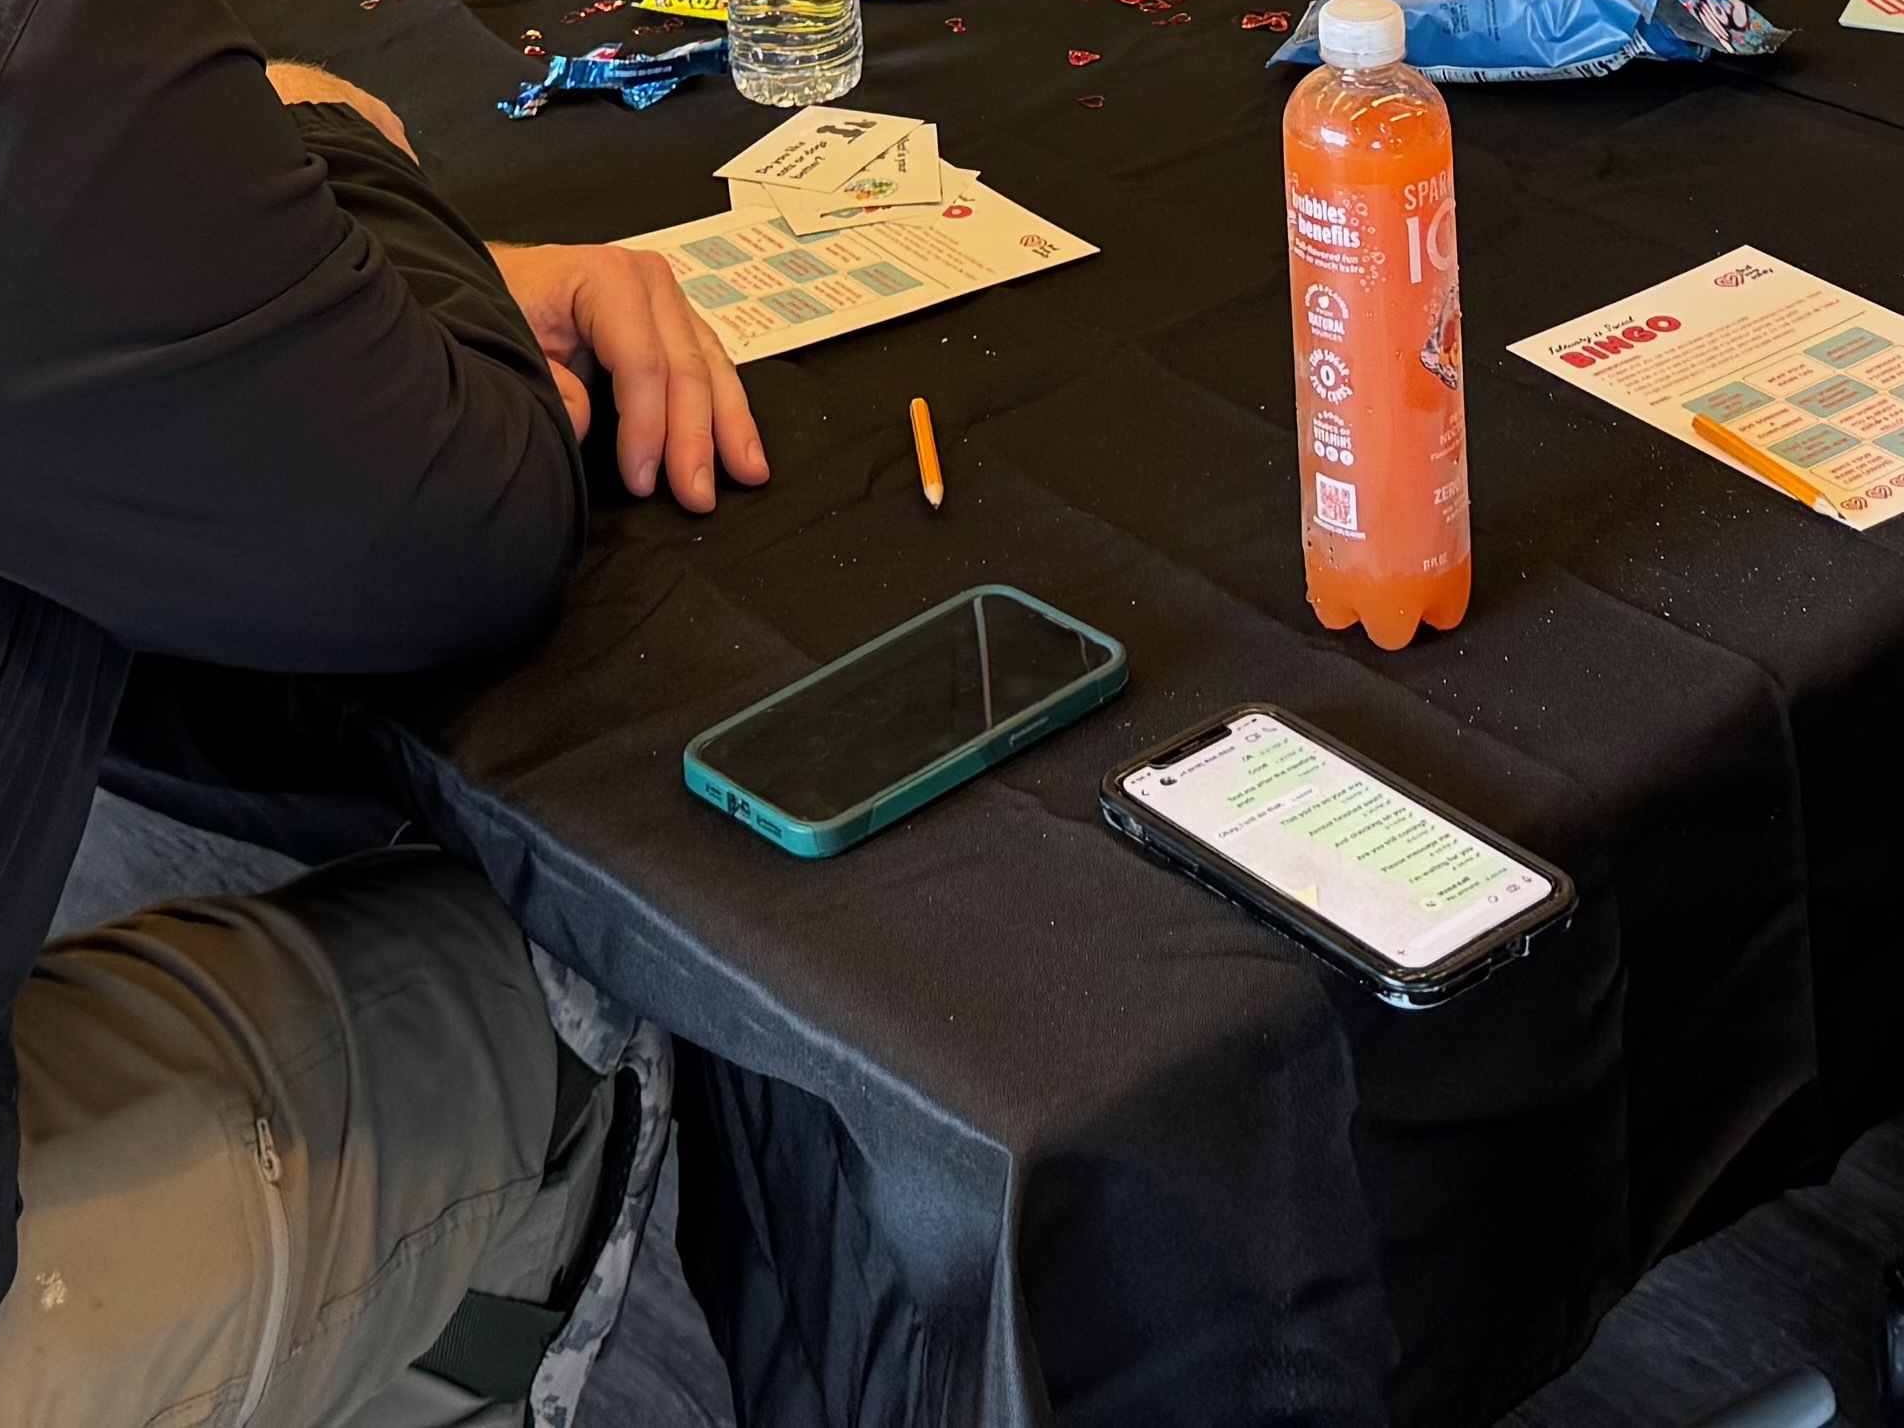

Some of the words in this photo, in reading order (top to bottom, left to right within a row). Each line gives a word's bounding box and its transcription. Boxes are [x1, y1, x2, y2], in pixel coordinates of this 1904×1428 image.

[1291, 186, 1347, 225] bubbles
[1298, 213, 1361, 249] benefits
[1405, 196, 1457, 284] IC
[1307, 311, 1346, 335] NATURAL
[1560, 315, 1682, 369] BINGO
[1320, 364, 1336, 387] 0
